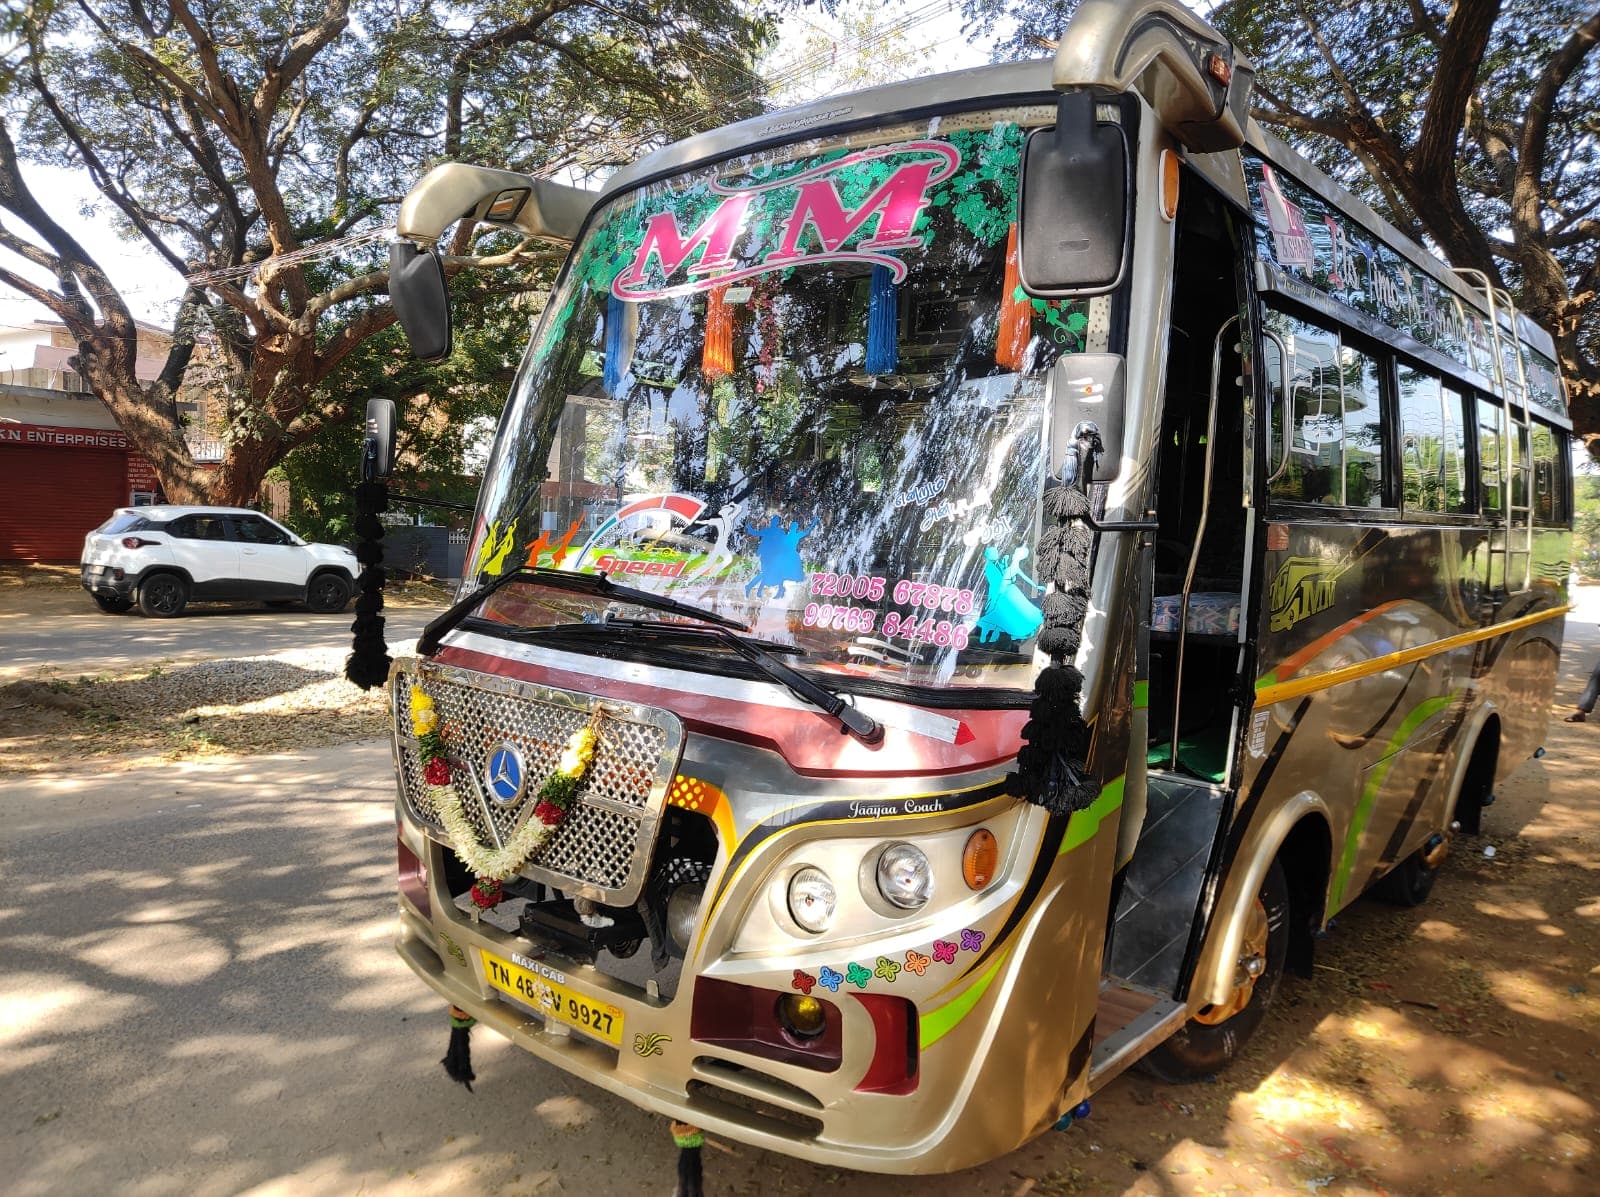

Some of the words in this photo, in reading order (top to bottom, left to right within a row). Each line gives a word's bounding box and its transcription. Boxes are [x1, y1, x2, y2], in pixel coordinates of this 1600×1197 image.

[593, 554, 688, 577] Speed
[811, 572, 886, 601] 72005
[893, 580, 974, 615] 67878
[803, 602, 875, 633] 99763
[882, 612, 969, 650] 84486
[904, 799, 944, 814] Coach
[511, 952, 539, 974] MAXI
[541, 967, 565, 985] CAB
[489, 960, 511, 987] TN
[516, 975, 535, 999] 48
[568, 999, 613, 1035] 9927
